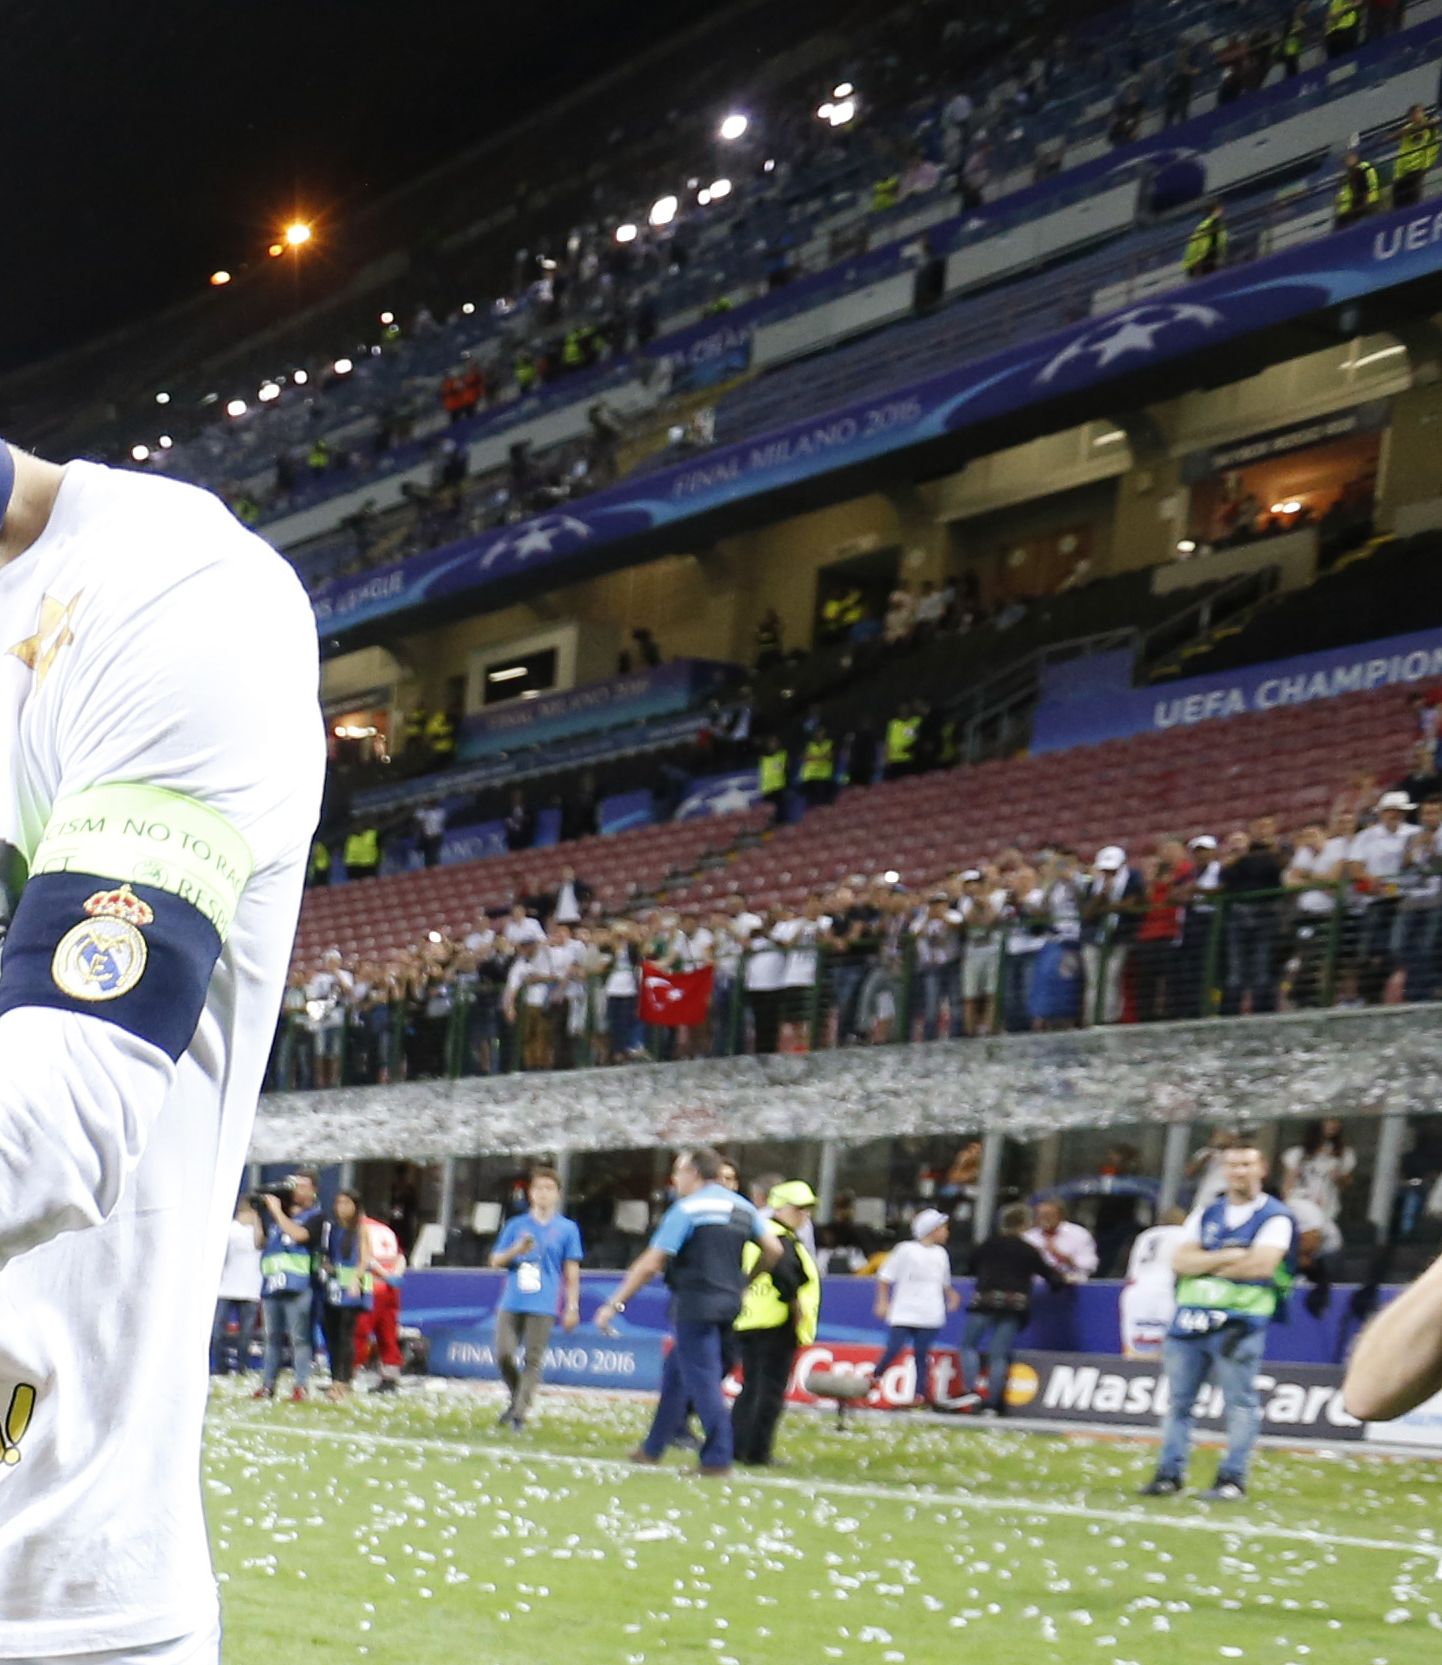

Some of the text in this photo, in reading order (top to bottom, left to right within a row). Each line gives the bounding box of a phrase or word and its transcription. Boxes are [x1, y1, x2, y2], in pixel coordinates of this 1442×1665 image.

[1153, 688, 1245, 729] UEFA
[123, 818, 171, 842] NO
[181, 830, 212, 861] TO
[592, 1350, 637, 1375] 2016
